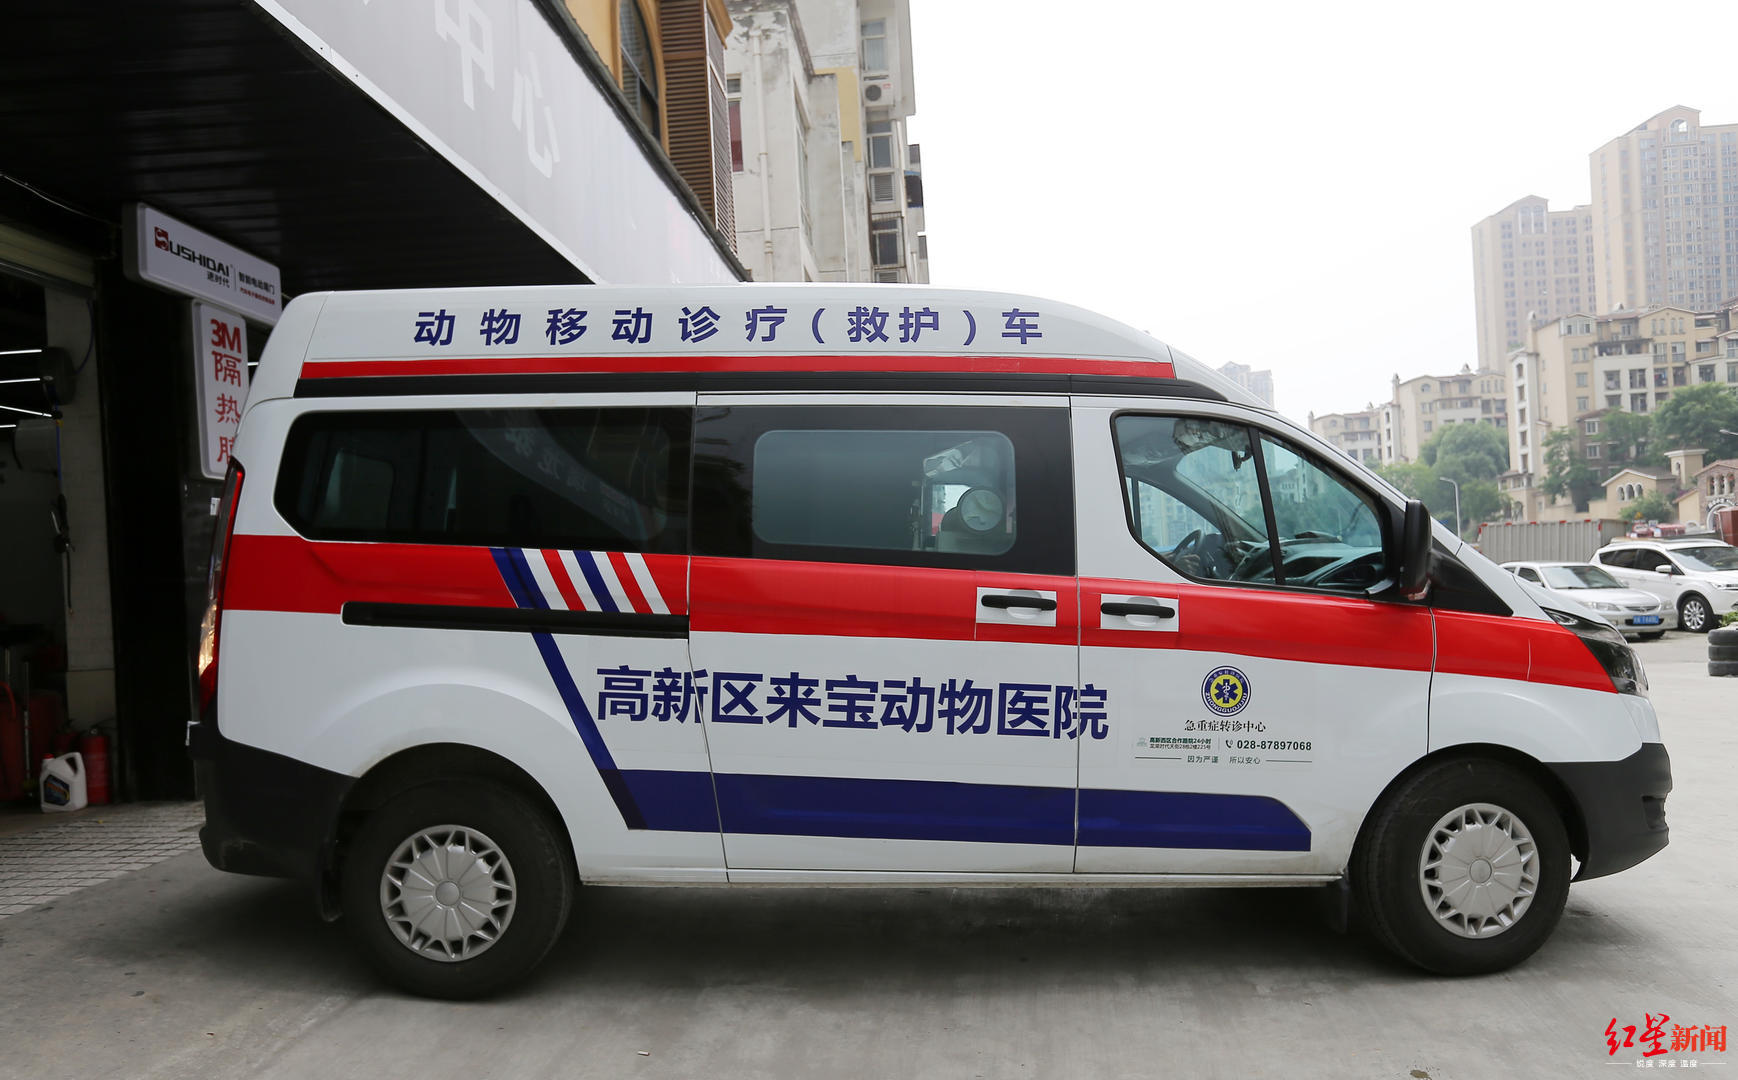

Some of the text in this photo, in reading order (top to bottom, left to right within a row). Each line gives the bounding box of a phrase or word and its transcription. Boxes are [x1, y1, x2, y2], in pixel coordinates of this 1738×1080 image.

[210, 318, 242, 354] 3M
[596, 664, 1110, 741] 高新区来宝动物医院
[1184, 719, 1267, 733] 急重症转诊中心
[1236, 739, 1312, 751] 028-87897068
[1187, 755, 1261, 765] 因为严谨 所以安心
